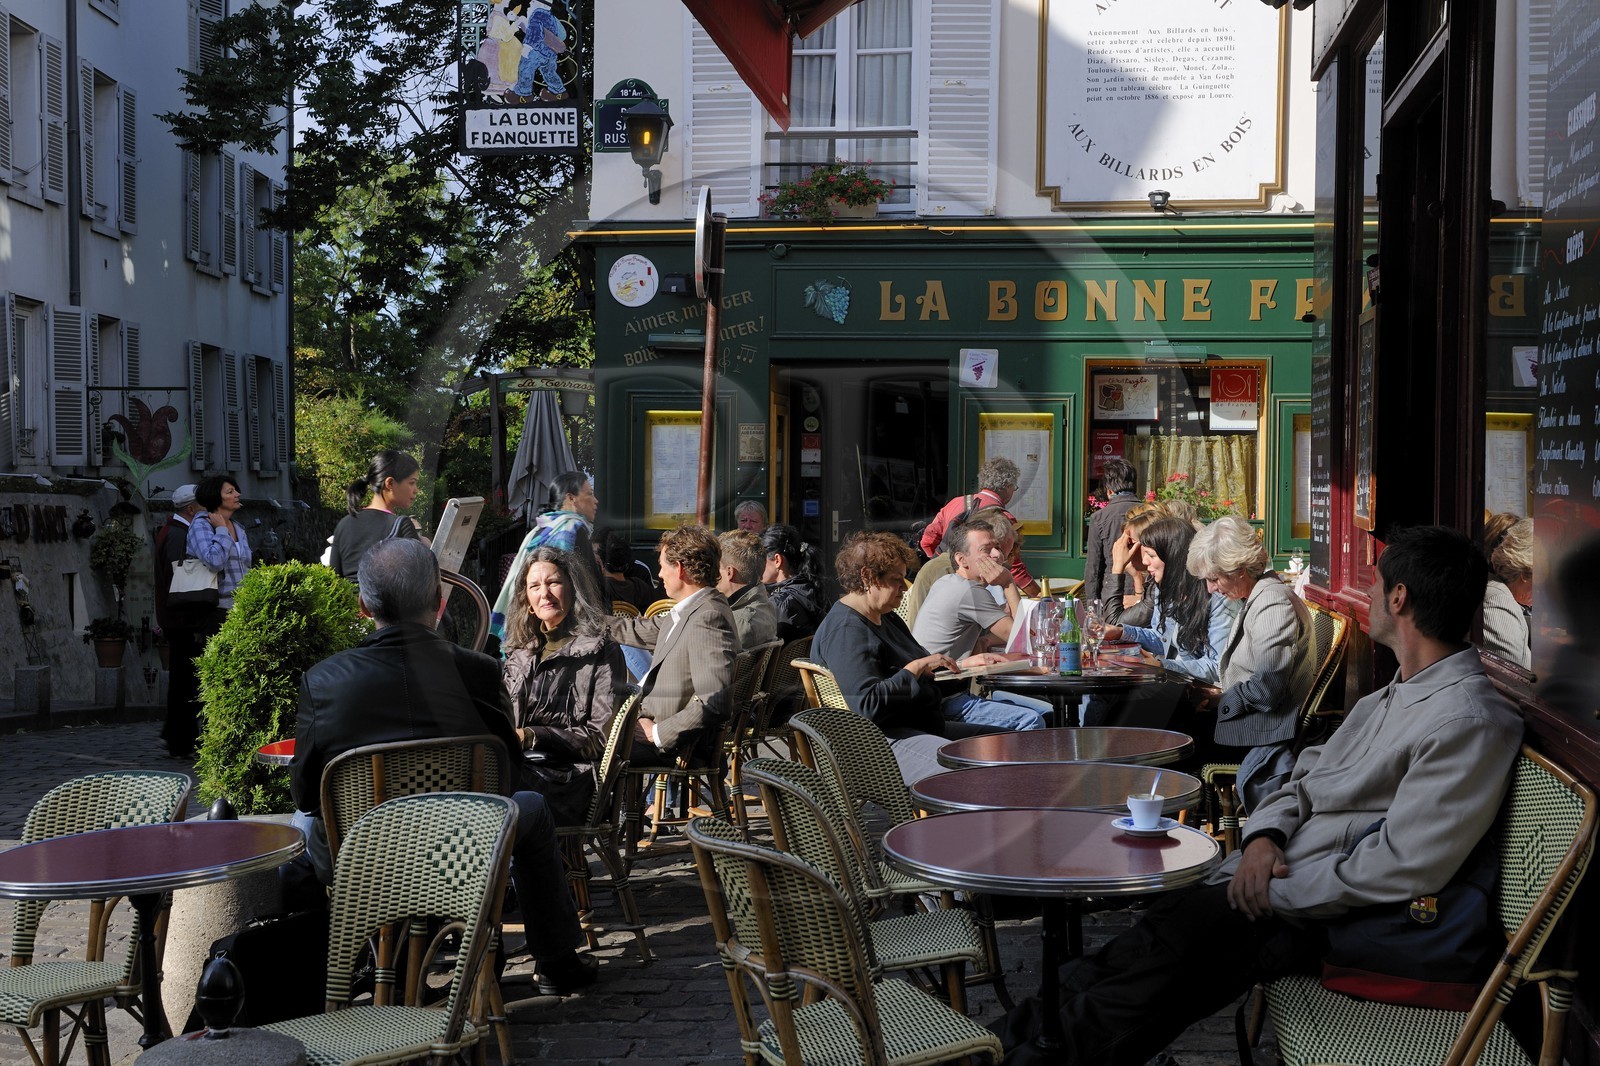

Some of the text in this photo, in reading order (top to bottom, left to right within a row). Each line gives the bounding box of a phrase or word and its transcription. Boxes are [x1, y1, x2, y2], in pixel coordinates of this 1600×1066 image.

[489, 111, 576, 126] LA BONNE
[471, 130, 576, 146] FRANQUETTE
[1098, 152, 1184, 181] BILLARDS
[1192, 152, 1216, 173] EN
[878, 280, 951, 322] LA
[988, 279, 1213, 322] BONNE
[518, 378, 536, 388] La
